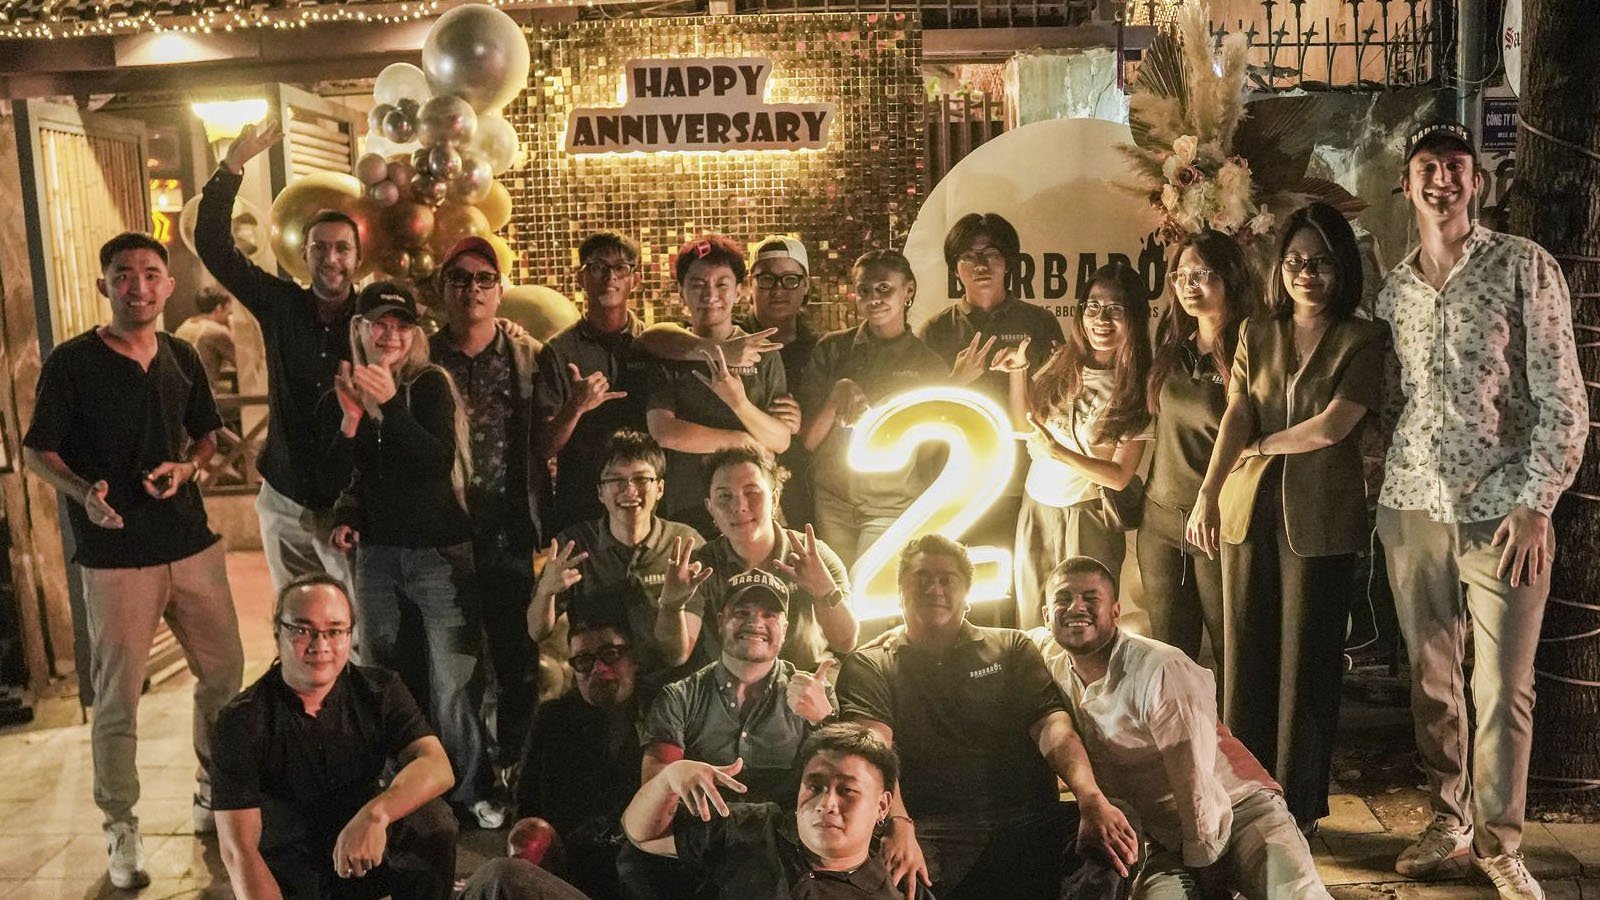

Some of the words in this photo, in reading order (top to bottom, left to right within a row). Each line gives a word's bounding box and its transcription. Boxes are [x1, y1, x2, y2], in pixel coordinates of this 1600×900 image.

[633, 65, 764, 98] HAPPY
[572, 111, 827, 146] ANNIVERSARY
[848, 386, 1015, 621] 2
[732, 574, 786, 594] BARBAROS
